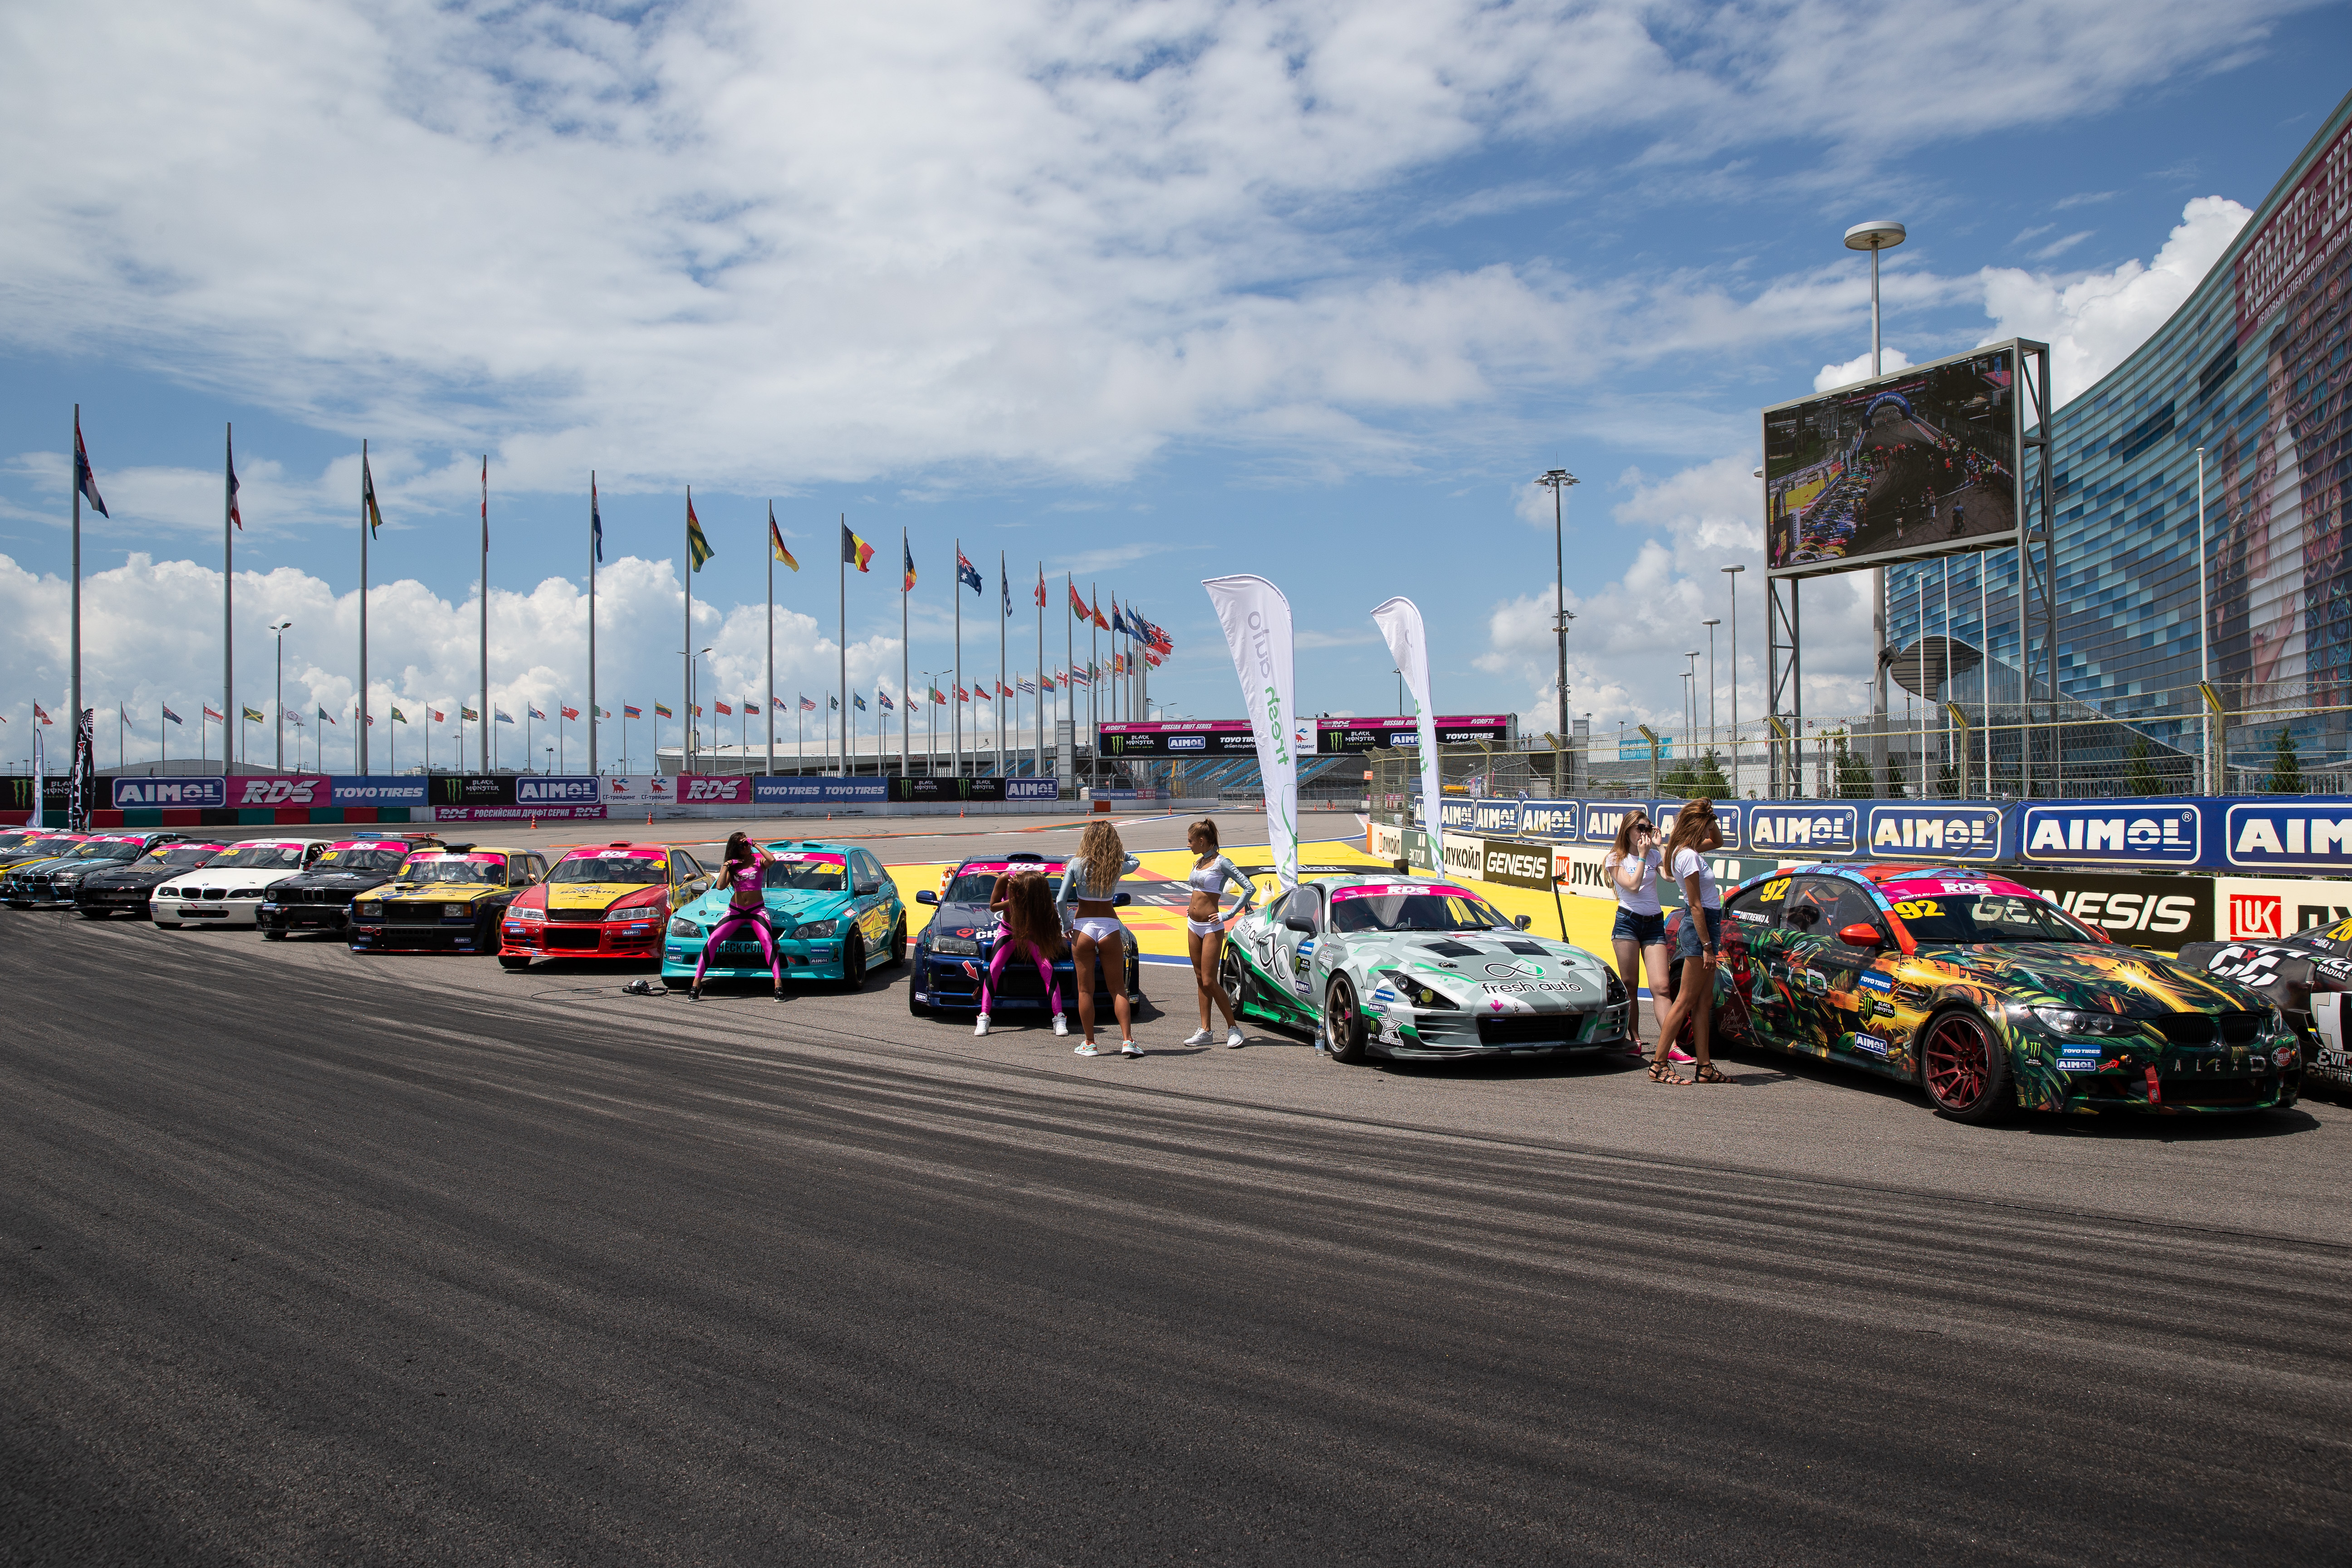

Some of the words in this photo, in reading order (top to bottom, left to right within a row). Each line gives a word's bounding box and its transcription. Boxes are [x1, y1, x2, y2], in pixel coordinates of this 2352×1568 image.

[2257, 288, 2285, 329] ЛЕДОВЫЙ
[2286, 250, 2324, 298] СПЕКТАКЛЬ
[2326, 225, 2347, 258] ИЛЬИ
[1866, 397, 1883, 416] TOYO
[1884, 395, 1906, 407] TIRES
[118, 784, 220, 802] AIMOL
[240, 780, 320, 804] RDS
[335, 788, 377, 798] TOYO
[379, 787, 424, 797] TIRES
[520, 783, 596, 799] AIMOL
[686, 780, 743, 800] RDS
[757, 786, 788, 795] TOYO
[788, 786, 820, 795] TIRES
[825, 786, 854, 795] TOYO
[854, 786, 885, 795] TIRES
[1008, 783, 1056, 795] AIMOL
[439, 808, 470, 819] RDS
[475, 807, 521, 817] РОССИЙСКАЯ
[521, 808, 548, 818] ДРИФТ
[549, 808, 570, 817] СЕРИЯ
[574, 807, 603, 817] RDS
[1441, 806, 1474, 826] AIMOL
[1476, 808, 1517, 829] AIMOL
[1522, 809, 1575, 833] AIMOL
[1588, 813, 1624, 835] AIM
[1754, 817, 1850, 844] AIMOL
[1874, 819, 1994, 850] AIMOL
[2030, 818, 2191, 851] AIMOL
[2235, 818, 2352, 854] AIM
[1382, 835, 1400, 855] ЛУКОЙЛ
[320, 852, 338, 861] 10
[1409, 848, 1421, 862] ЭКТО
[1445, 846, 1480, 871] ЛУКОЙЛ
[399, 864, 412, 876] 9
[652, 860, 666, 869] 4
[819, 864, 845, 875] 87
[1487, 851, 1547, 879] GENESIS
[1230, 864, 1244, 882] fresh
[1243, 879, 1254, 893] auto
[1940, 883, 1992, 892] RDS
[1760, 877, 1792, 902] 92
[1739, 911, 1764, 924] DMITRENKO
[1764, 915, 1769, 924] A.
[1893, 900, 1945, 919] 92
[716, 942, 744, 953] HECK
[2317, 964, 2346, 980] RADIAL
[1296, 982, 1310, 993] AIMOL
[1480, 980, 1537, 995] fresh
[1538, 980, 1582, 992] auto
[1861, 976, 1875, 984] TOYO
[1875, 979, 1891, 989] TIRES
[1874, 1005, 1894, 1014] MONSTER
[1856, 1036, 1886, 1052] AIMOL
[2317, 1048, 2347, 1068] EVIL
[2306, 1062, 2352, 1084] EMPIR
